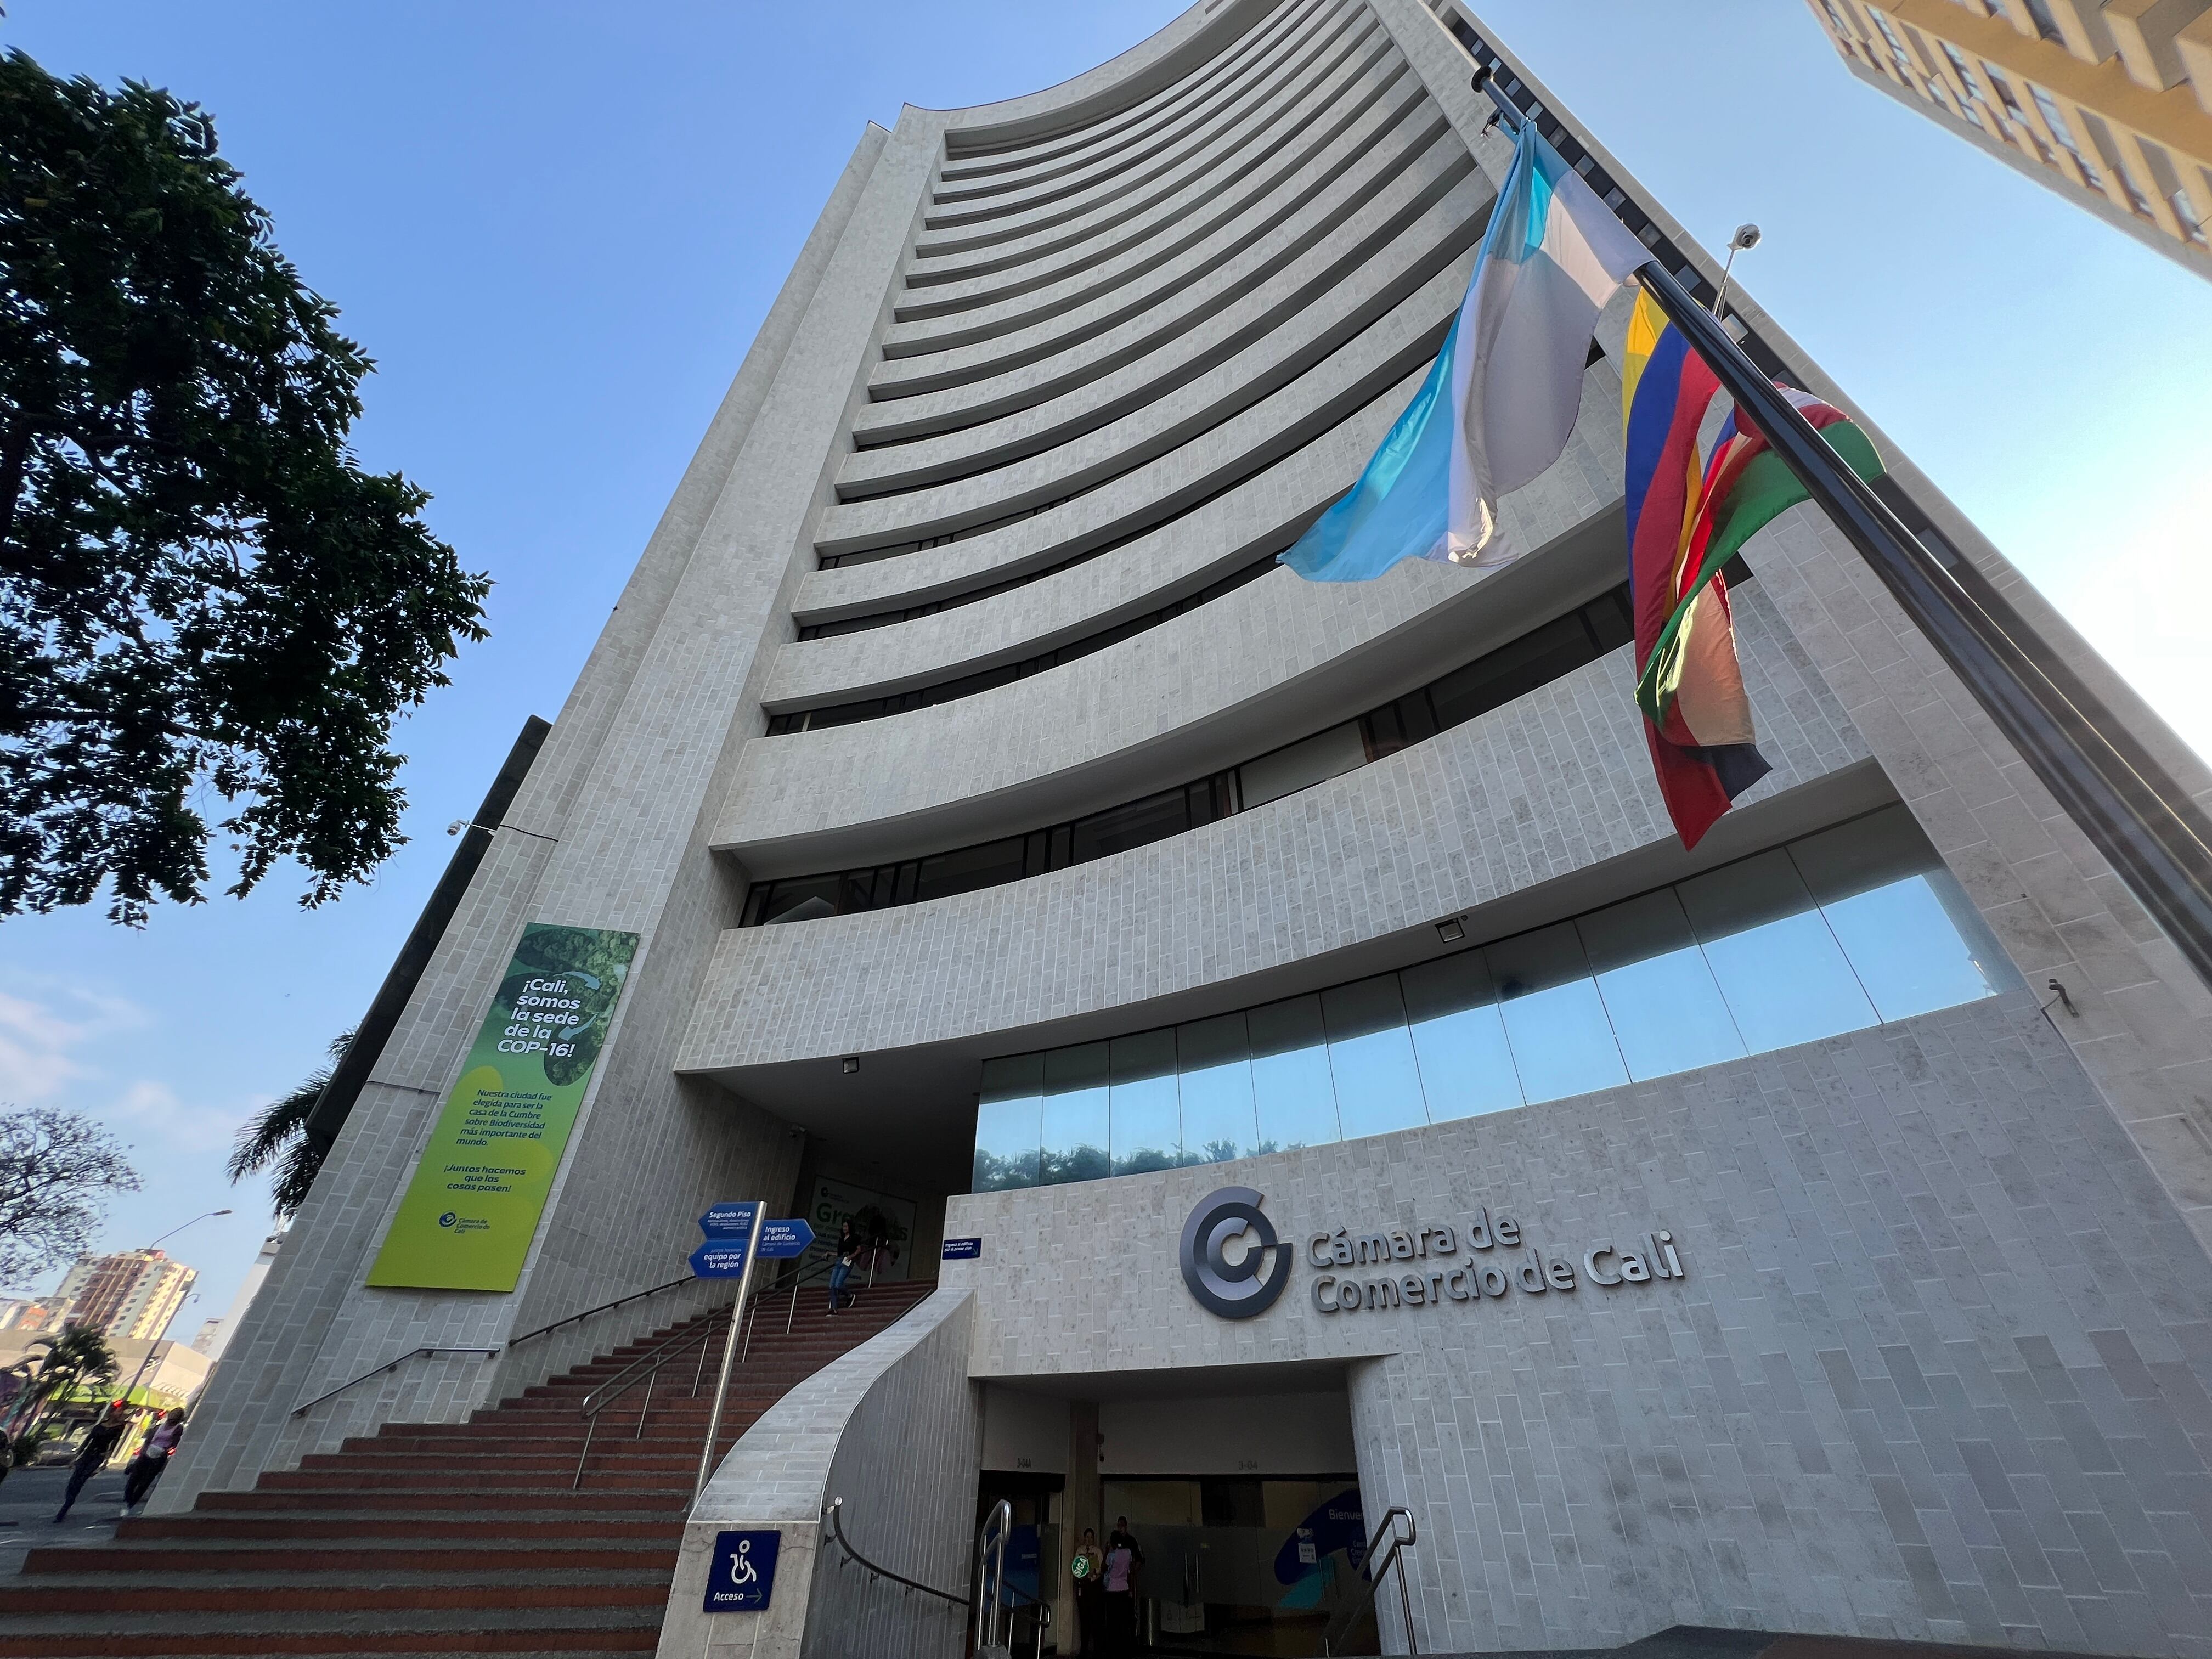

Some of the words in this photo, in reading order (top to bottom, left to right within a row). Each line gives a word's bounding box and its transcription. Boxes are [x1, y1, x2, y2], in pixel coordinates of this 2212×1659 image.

[522, 979, 568, 995] ¡Cali,
[516, 995, 580, 1009] somos
[510, 1008, 530, 1022] la
[532, 1011, 579, 1025] sede
[504, 1024, 529, 1037] de
[532, 1025, 552, 1039] la
[497, 1039, 575, 1057] COP-16!
[477, 1089, 509, 1098] Nuestra
[510, 1091, 538, 1100] ciudad
[473, 1099, 502, 1108] elegida
[509, 1110, 541, 1119] Cumbre
[489, 1119, 545, 1129] Biodiversidad
[479, 1128, 527, 1138] importante
[456, 1138, 488, 1146] mundo.
[443, 1164, 481, 1172] ¡Juntos
[482, 1166, 526, 1175] hacemos
[1307, 1224, 1457, 1268] Cámara
[1468, 1207, 1523, 1250] de
[704, 1253, 727, 1261] equipo
[716, 1261, 739, 1269] región
[1311, 1256, 1506, 1313] Comercio
[1515, 1248, 1577, 1294] de
[1583, 1229, 1684, 1287] Cali
[1074, 1558, 1087, 1576] SIGA
[713, 1592, 744, 1601] Acceso
